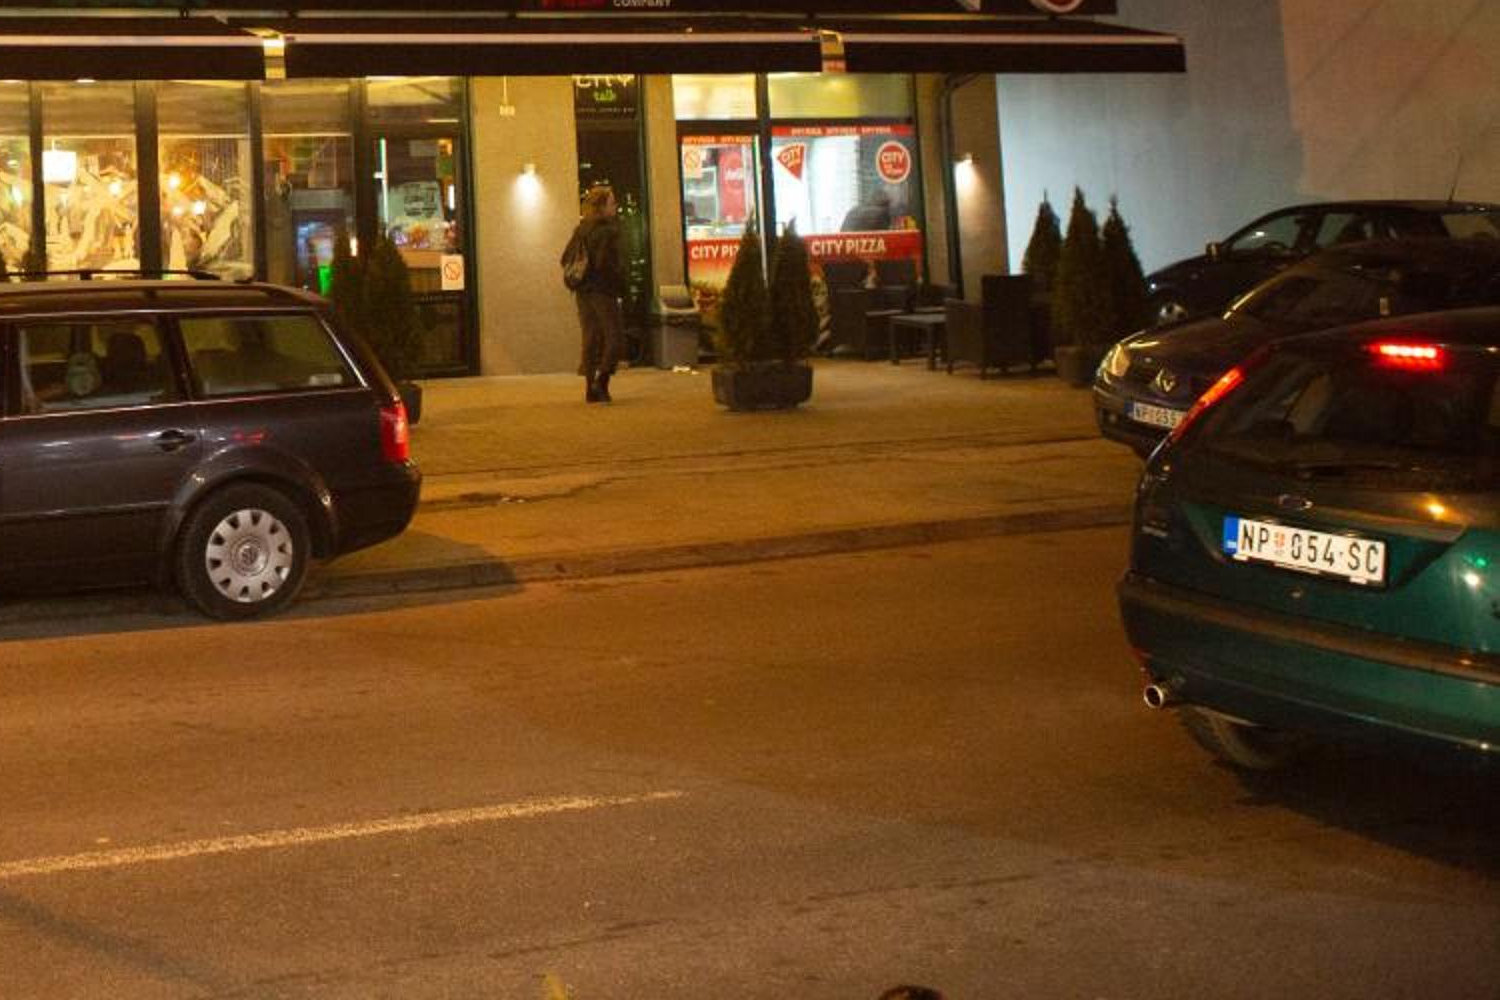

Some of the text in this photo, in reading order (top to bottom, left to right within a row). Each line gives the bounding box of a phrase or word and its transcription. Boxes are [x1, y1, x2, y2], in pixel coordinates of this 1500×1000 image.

[691, 246, 720, 259] CITY
[811, 238, 887, 255] CITY PIZZA
[1240, 522, 1271, 553] NP
